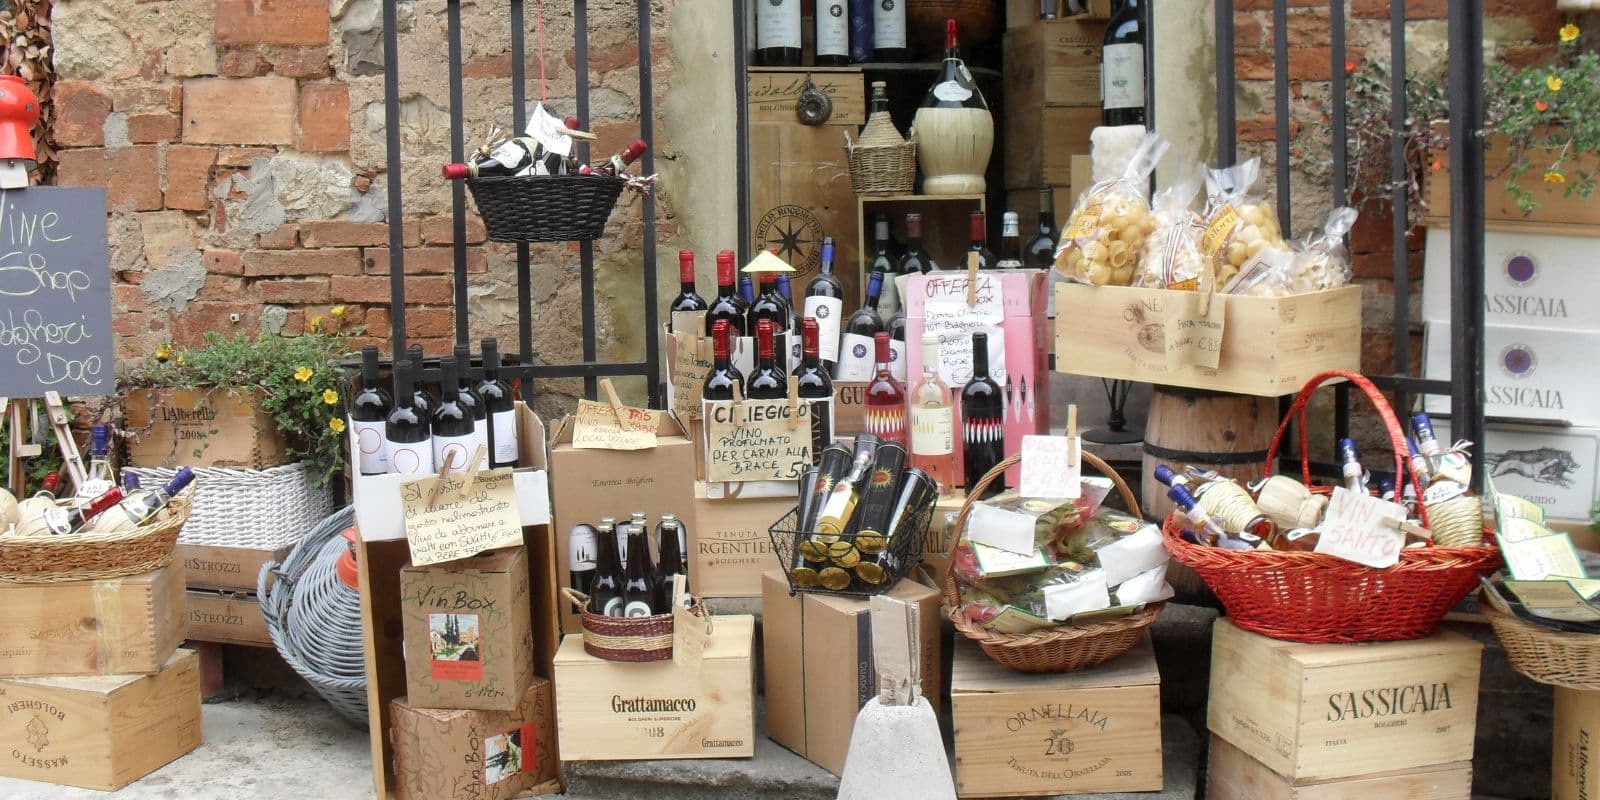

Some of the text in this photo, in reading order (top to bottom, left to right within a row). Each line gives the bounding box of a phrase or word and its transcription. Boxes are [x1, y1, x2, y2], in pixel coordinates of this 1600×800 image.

[1483, 294, 1568, 319] ASSICAIA
[718, 436, 791, 448] PROFUMATO
[731, 427, 762, 439] VINO
[713, 449, 737, 464] PER
[743, 448, 778, 460] CARNI
[729, 460, 780, 475] BRACE
[1337, 492, 1377, 522] VIN
[1328, 525, 1396, 556] SANTO
[7, 700, 66, 721] BOLGHERI
[612, 694, 696, 714] Grattamacco
[1327, 682, 1453, 723] SASSICAIA
[1006, 703, 1110, 732] ORNELLAIA
[1374, 719, 1408, 729] BOLGHERI
[701, 738, 744, 749] Grattamacco
[12, 749, 69, 769] MASSETO
[1007, 755, 1039, 777] TENUTA
